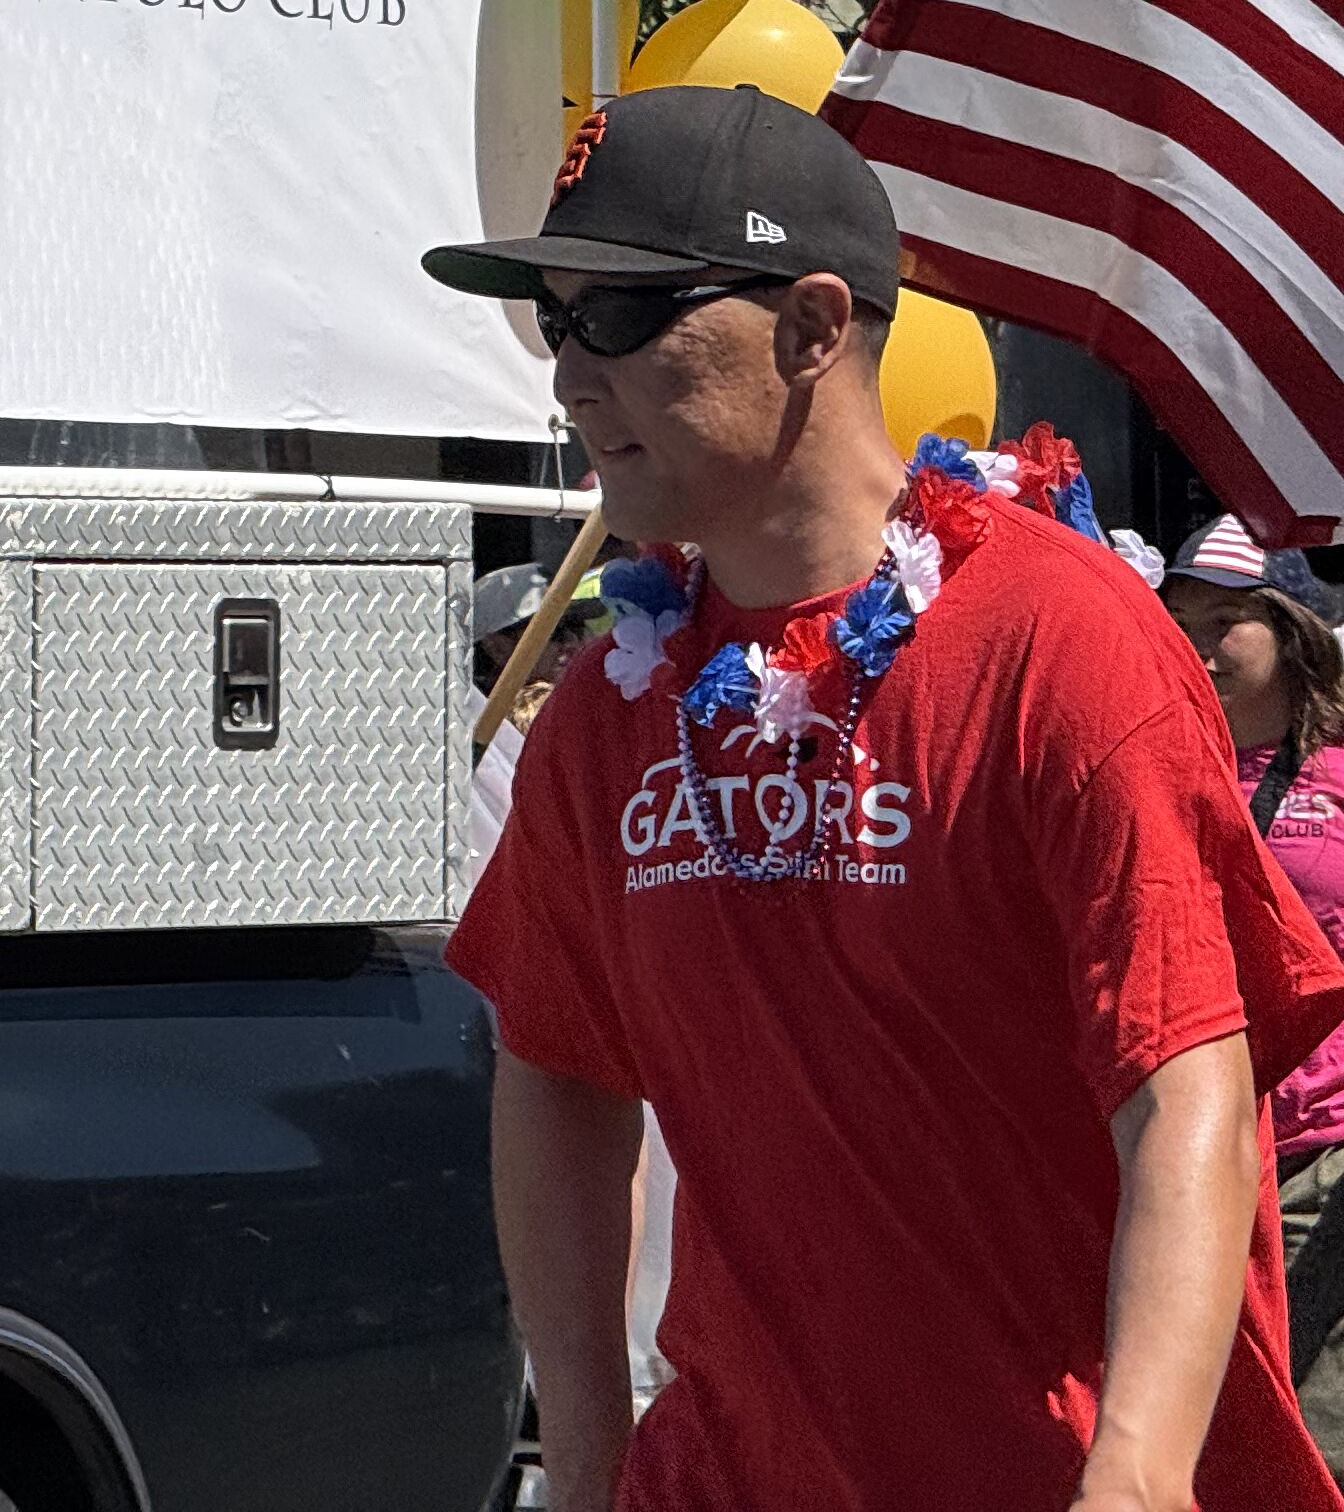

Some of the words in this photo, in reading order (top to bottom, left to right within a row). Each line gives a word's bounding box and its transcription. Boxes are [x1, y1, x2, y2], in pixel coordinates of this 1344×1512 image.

[619, 773, 912, 857] GATORS
[1271, 823, 1324, 839] CLUB
[834, 852, 907, 885] Team
